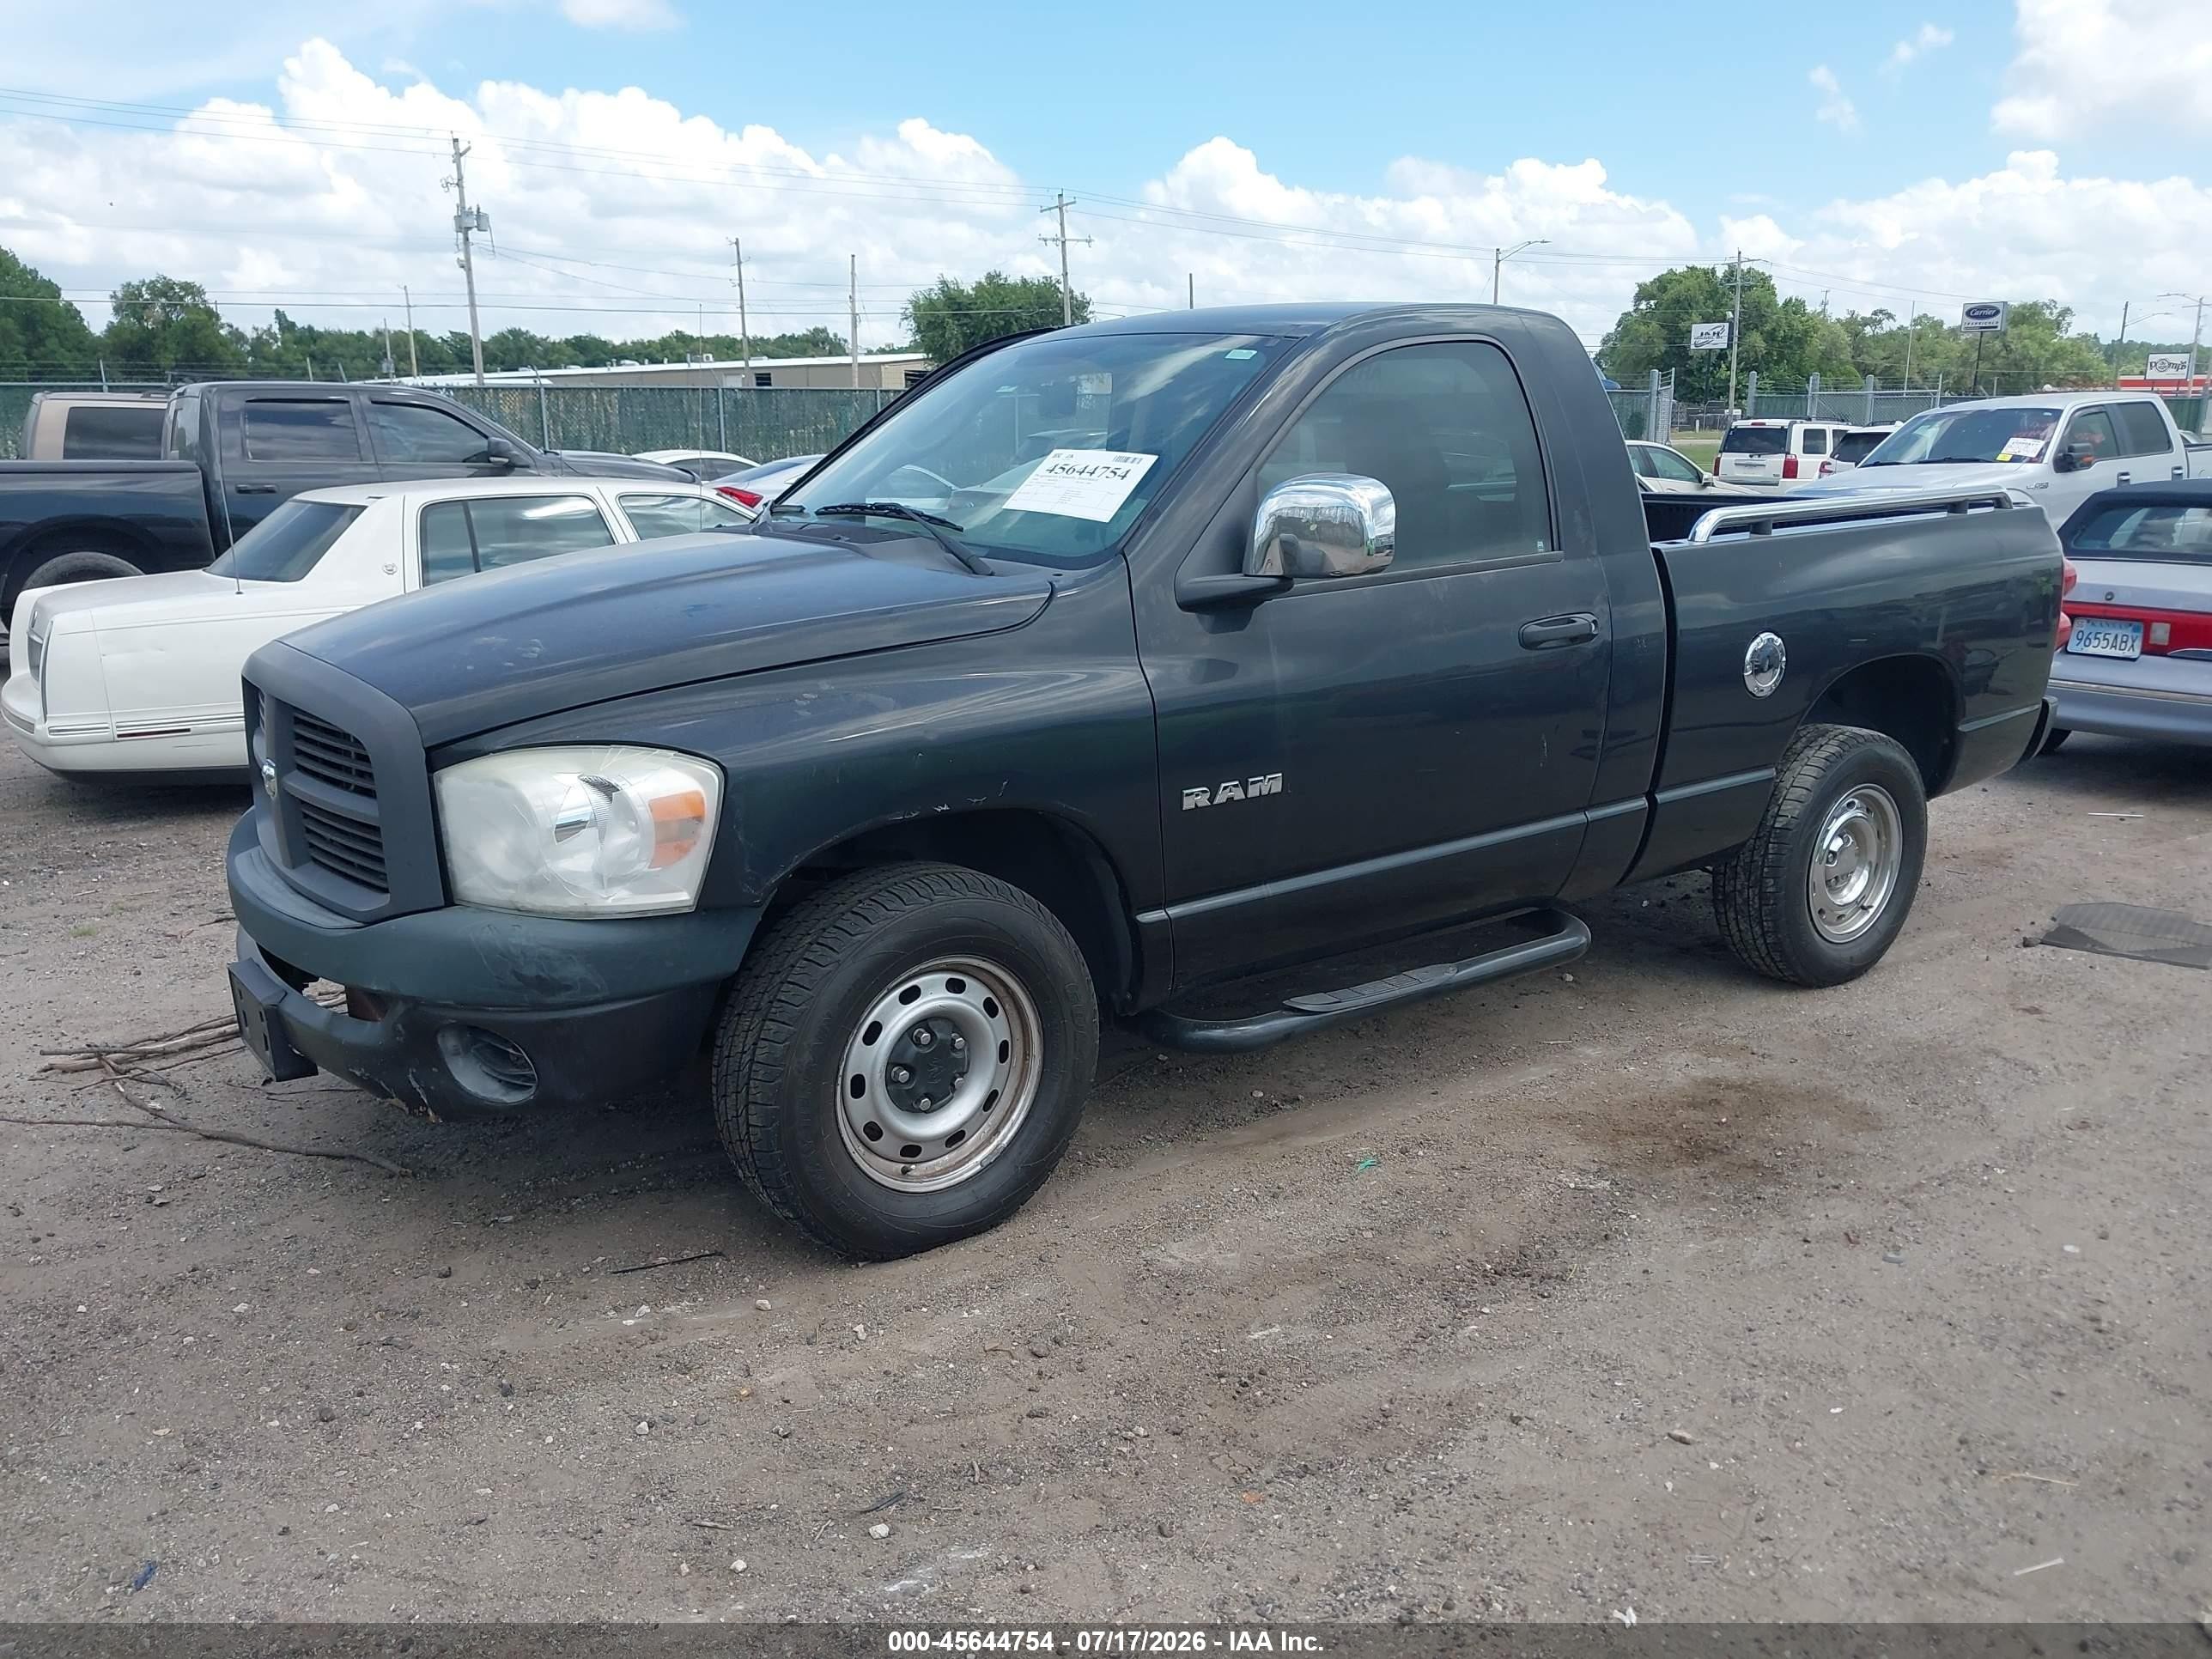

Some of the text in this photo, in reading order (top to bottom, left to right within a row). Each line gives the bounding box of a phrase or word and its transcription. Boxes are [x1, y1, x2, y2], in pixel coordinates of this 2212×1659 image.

[1046, 463, 1131, 481] 45644754
[2075, 629, 2138, 653] 9655ABX
[1182, 772, 1283, 811] RAM
